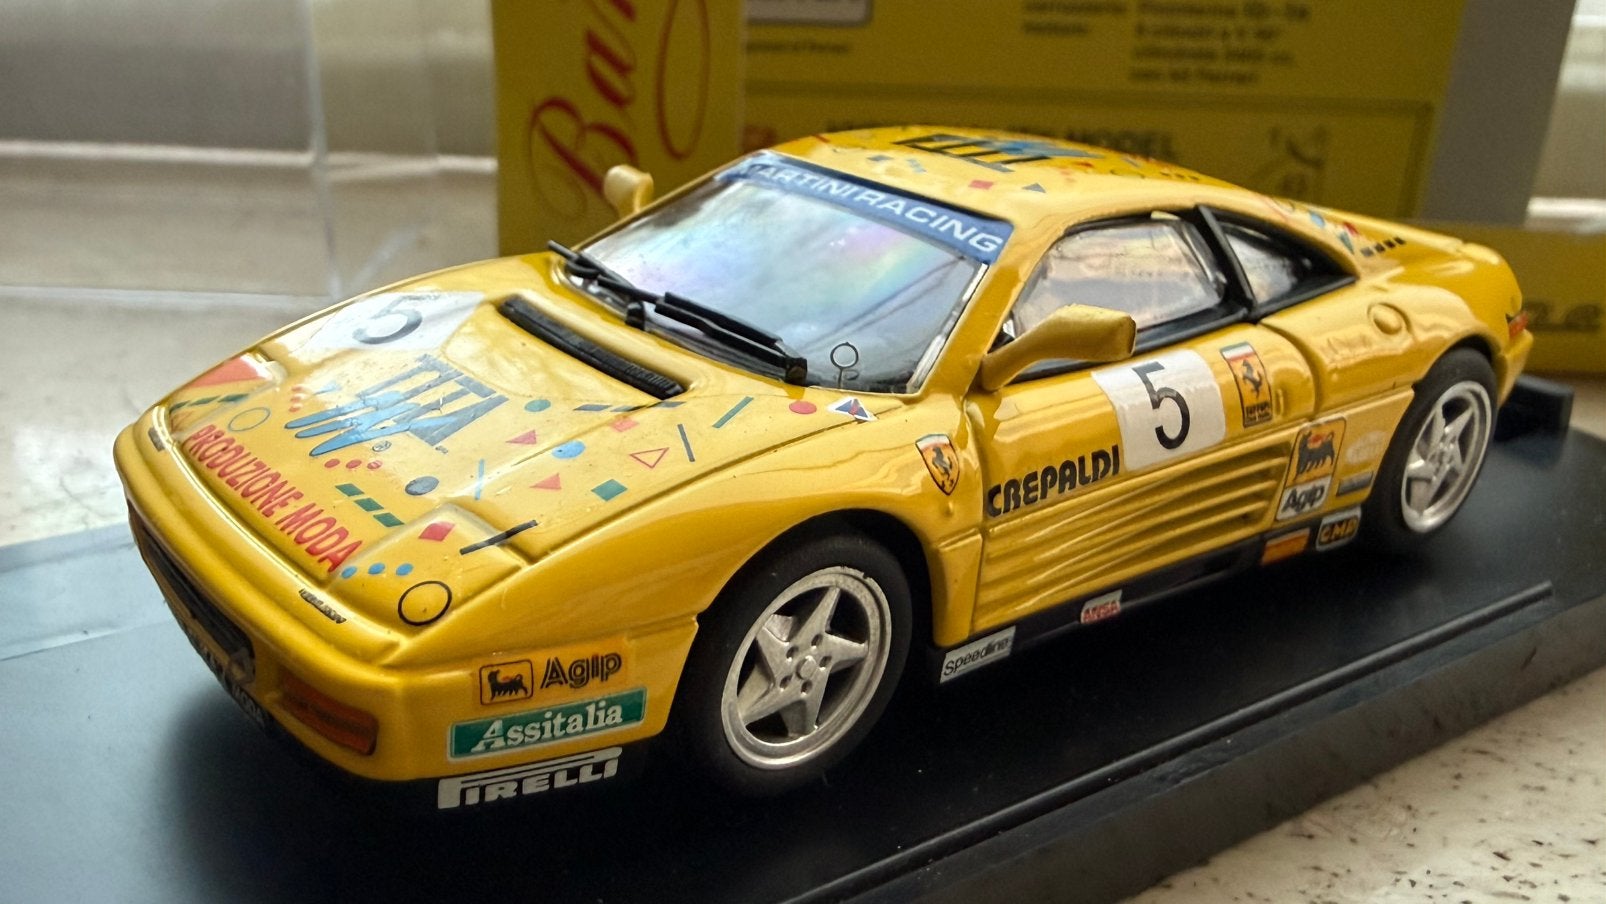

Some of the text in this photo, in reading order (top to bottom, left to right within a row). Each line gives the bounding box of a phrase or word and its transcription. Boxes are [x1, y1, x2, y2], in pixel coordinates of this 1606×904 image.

[854, 189, 1004, 253] RACING
[352, 294, 442, 345] 5
[1132, 361, 1190, 449] 5
[182, 424, 363, 573] PRODUZIONE MODA
[986, 444, 1120, 518] CREPALDI
[1281, 485, 1325, 513] Agip
[539, 652, 623, 690] Agip
[943, 637, 1010, 677] Speedline
[470, 700, 624, 753] Assitalia
[437, 746, 623, 810] PIRELLI
